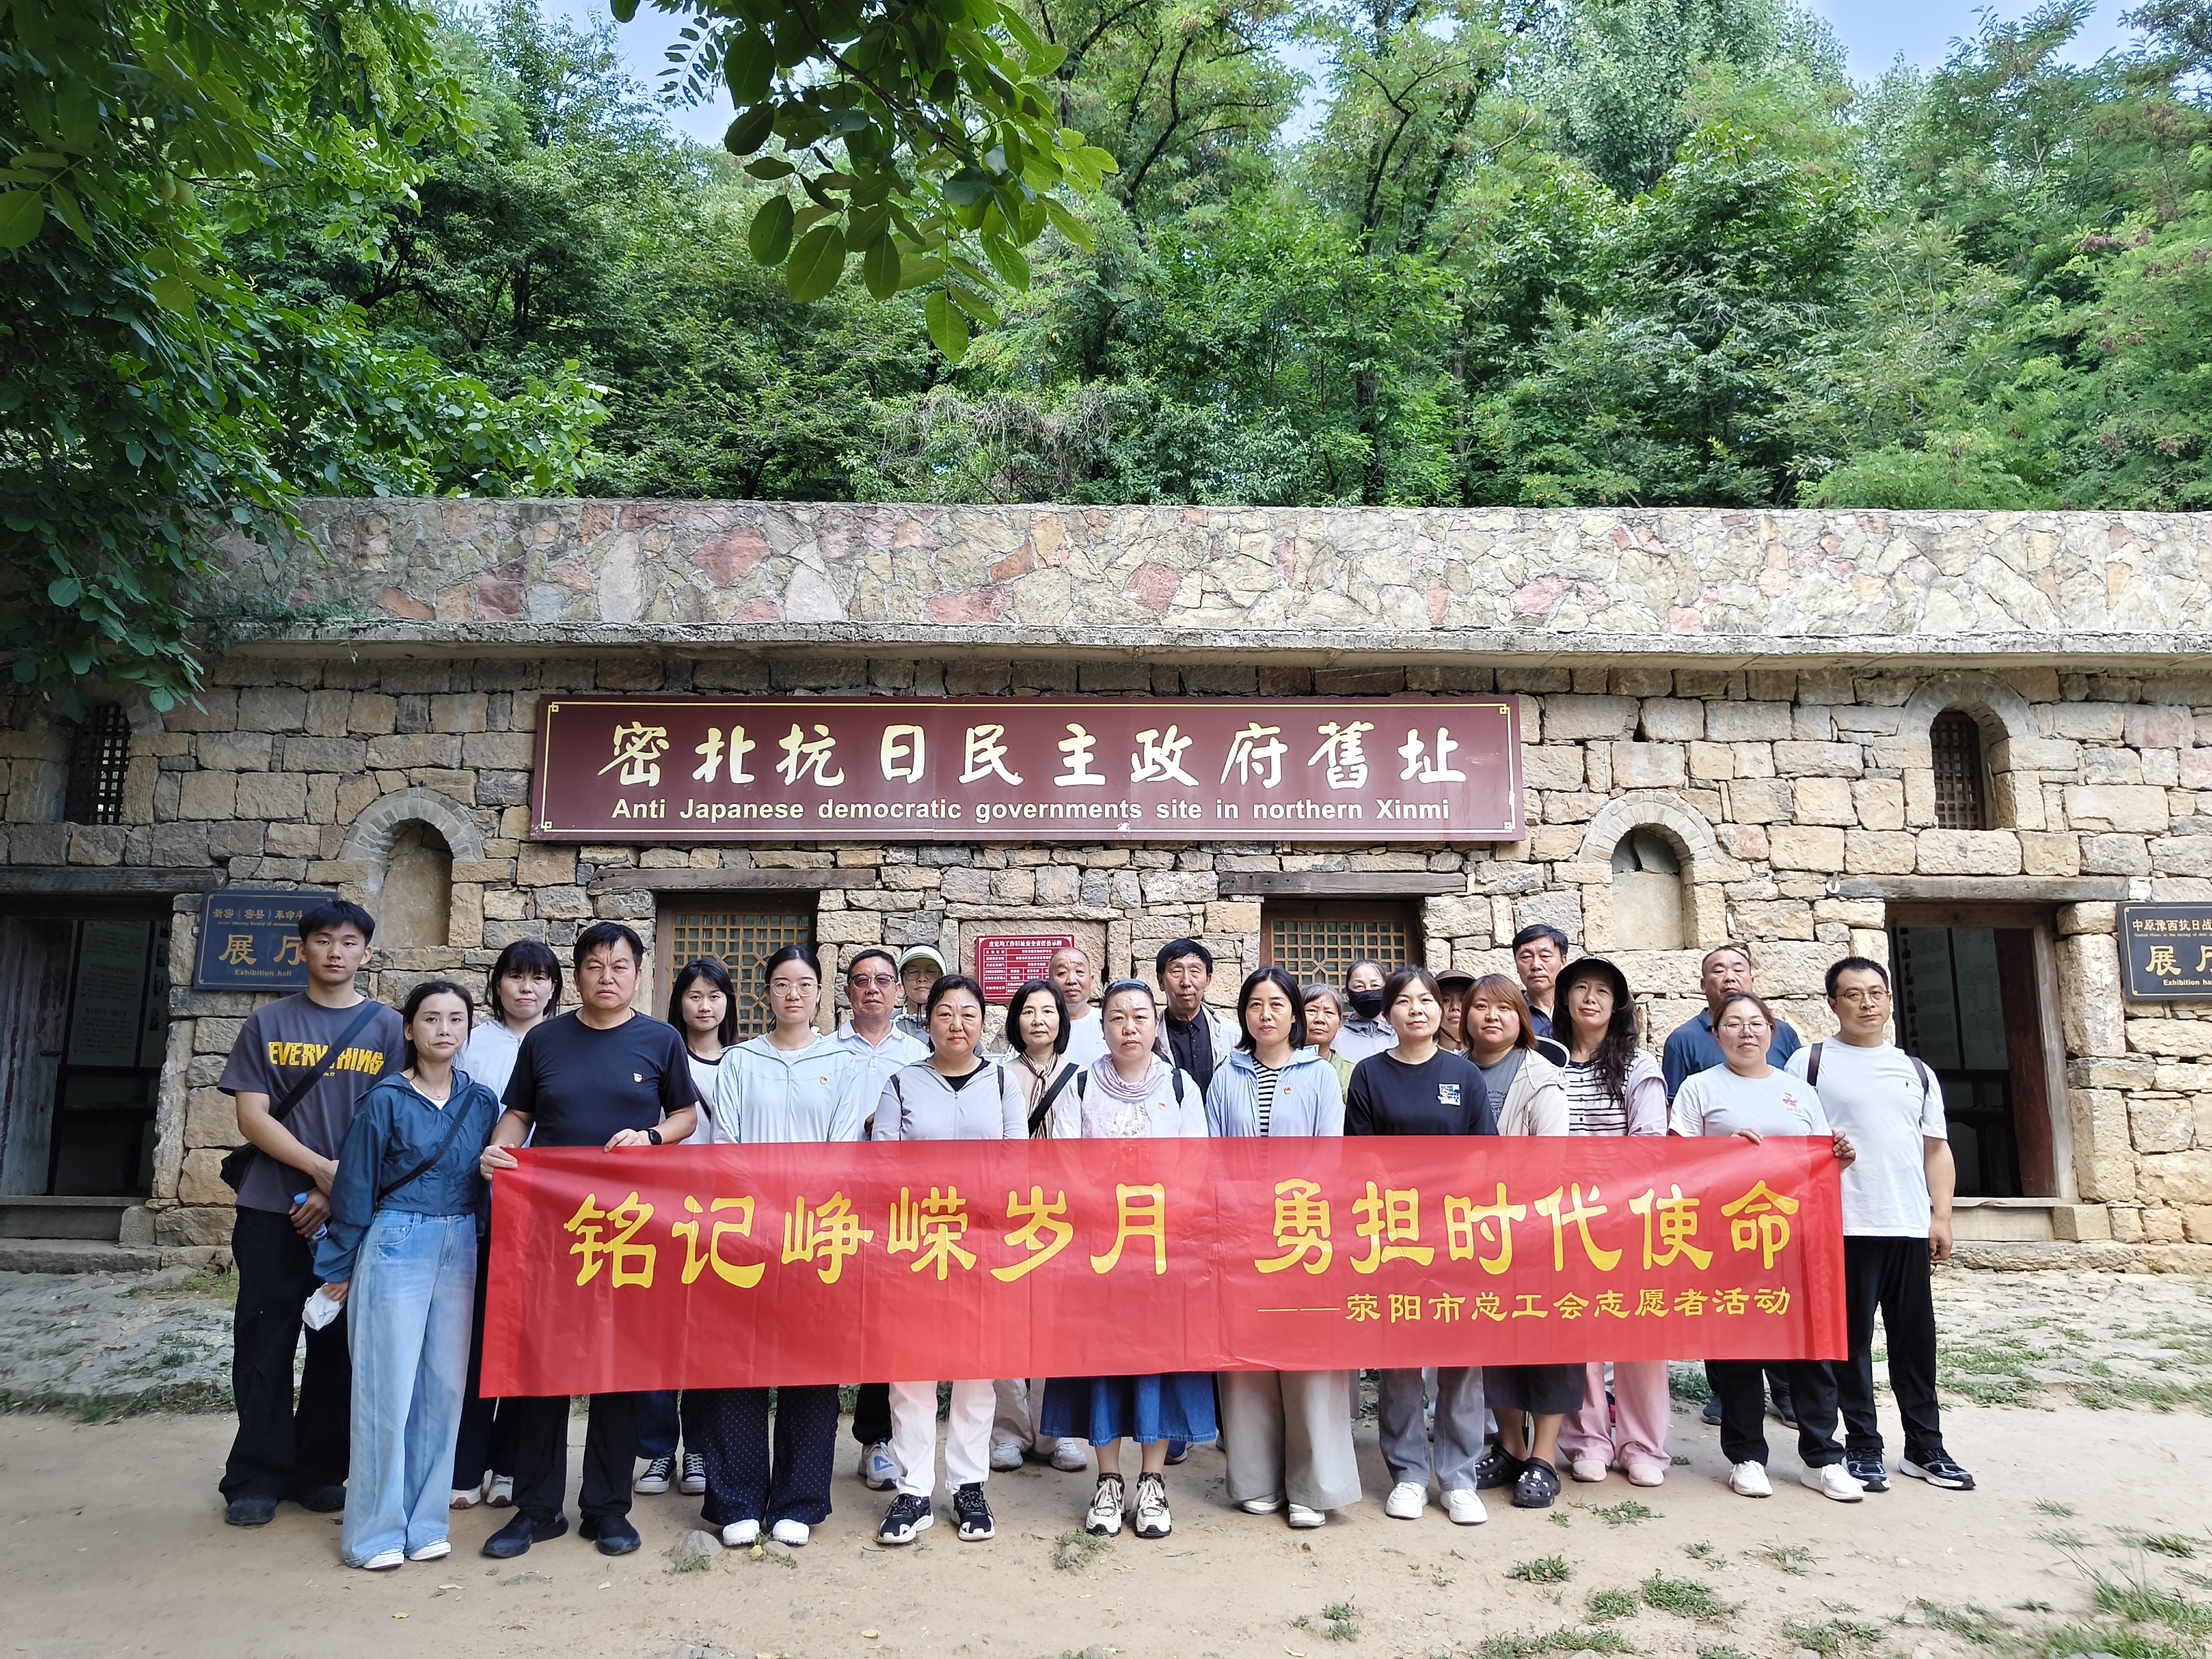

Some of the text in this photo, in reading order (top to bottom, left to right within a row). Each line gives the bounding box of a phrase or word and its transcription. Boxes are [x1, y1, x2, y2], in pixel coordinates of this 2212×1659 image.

[597, 720, 1468, 791] 密北抗日民主政府舊址
[611, 798, 1449, 824] Anti Japanese democratic governments site in northern Xinmi
[219, 934, 302, 966] 展厅
[235, 968, 274, 976] Exhibition
[268, 1041, 385, 1075] EVERYHING
[563, 1177, 1800, 1289] 铭记峥嵘岁月 勇担时代使命
